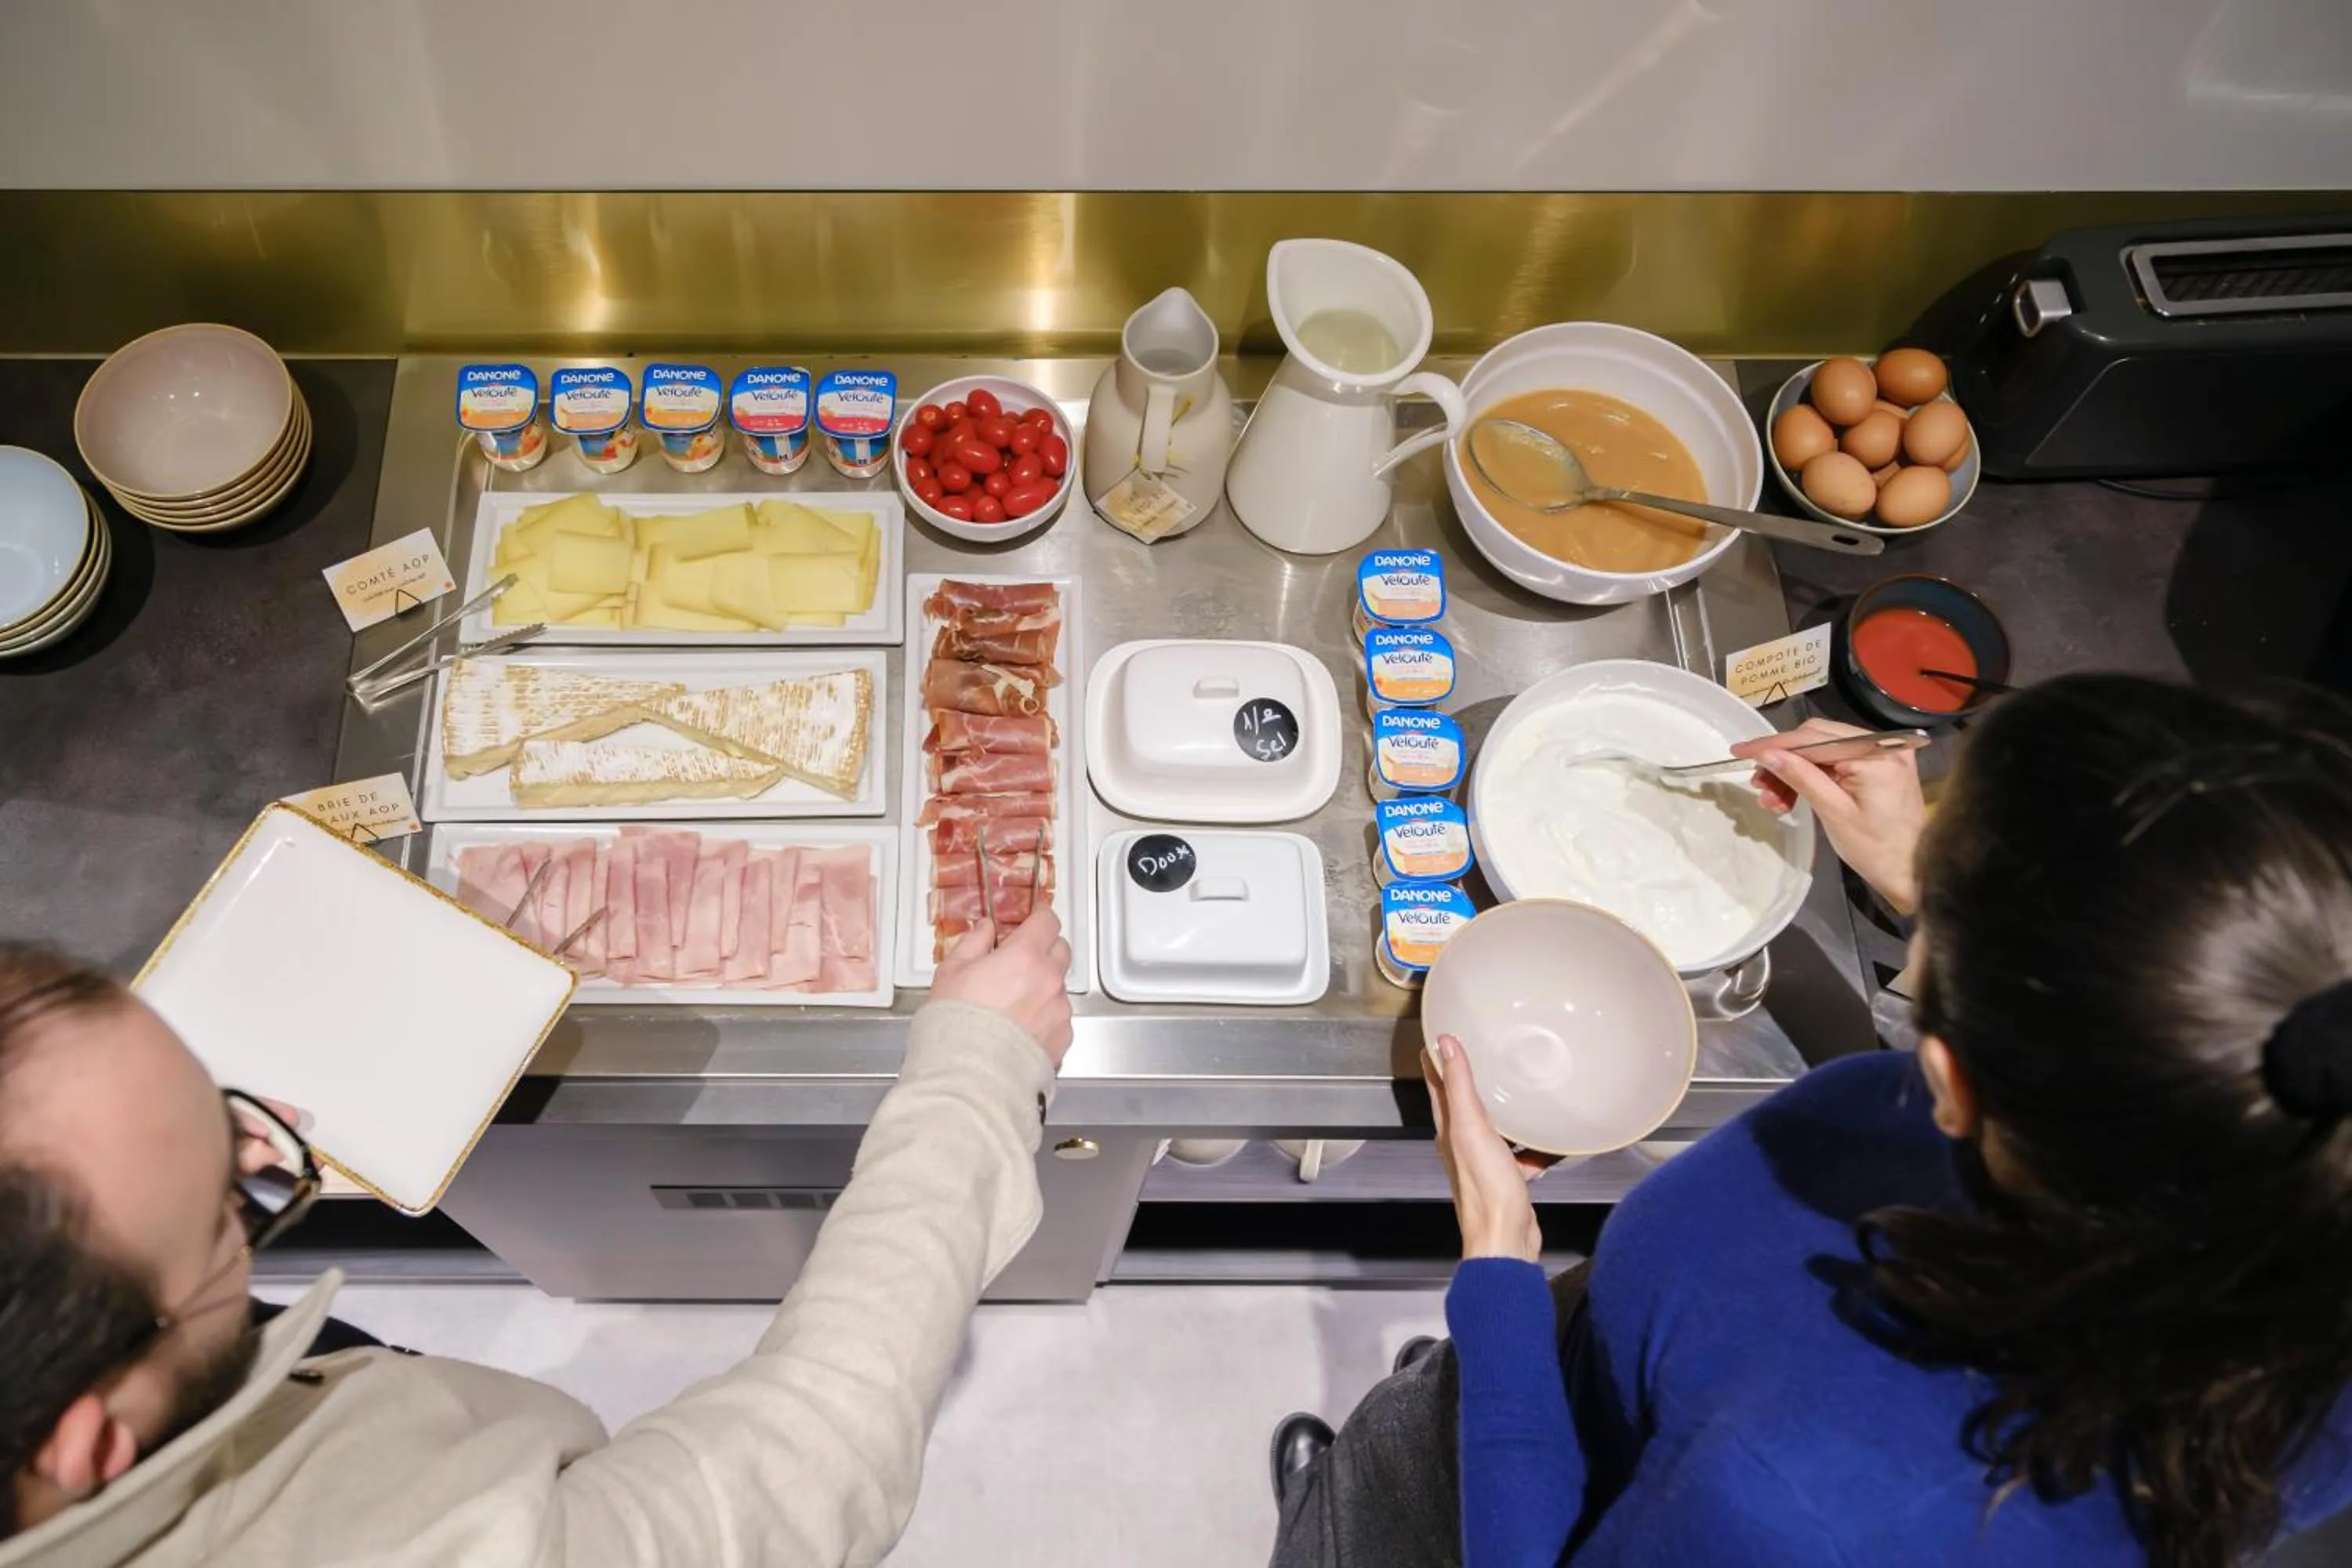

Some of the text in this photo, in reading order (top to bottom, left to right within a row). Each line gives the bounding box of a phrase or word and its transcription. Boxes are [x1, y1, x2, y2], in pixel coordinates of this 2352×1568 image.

[402, 554, 430, 572] AOP
[1735, 639, 1821, 674] COMPOTE DE
[1740, 665, 1787, 686] POMME
[1794, 655, 1817, 669] BIO
[318, 792, 378, 812] BRIE DE
[369, 802, 400, 815] AOP
[1138, 844, 1190, 876] Doux
